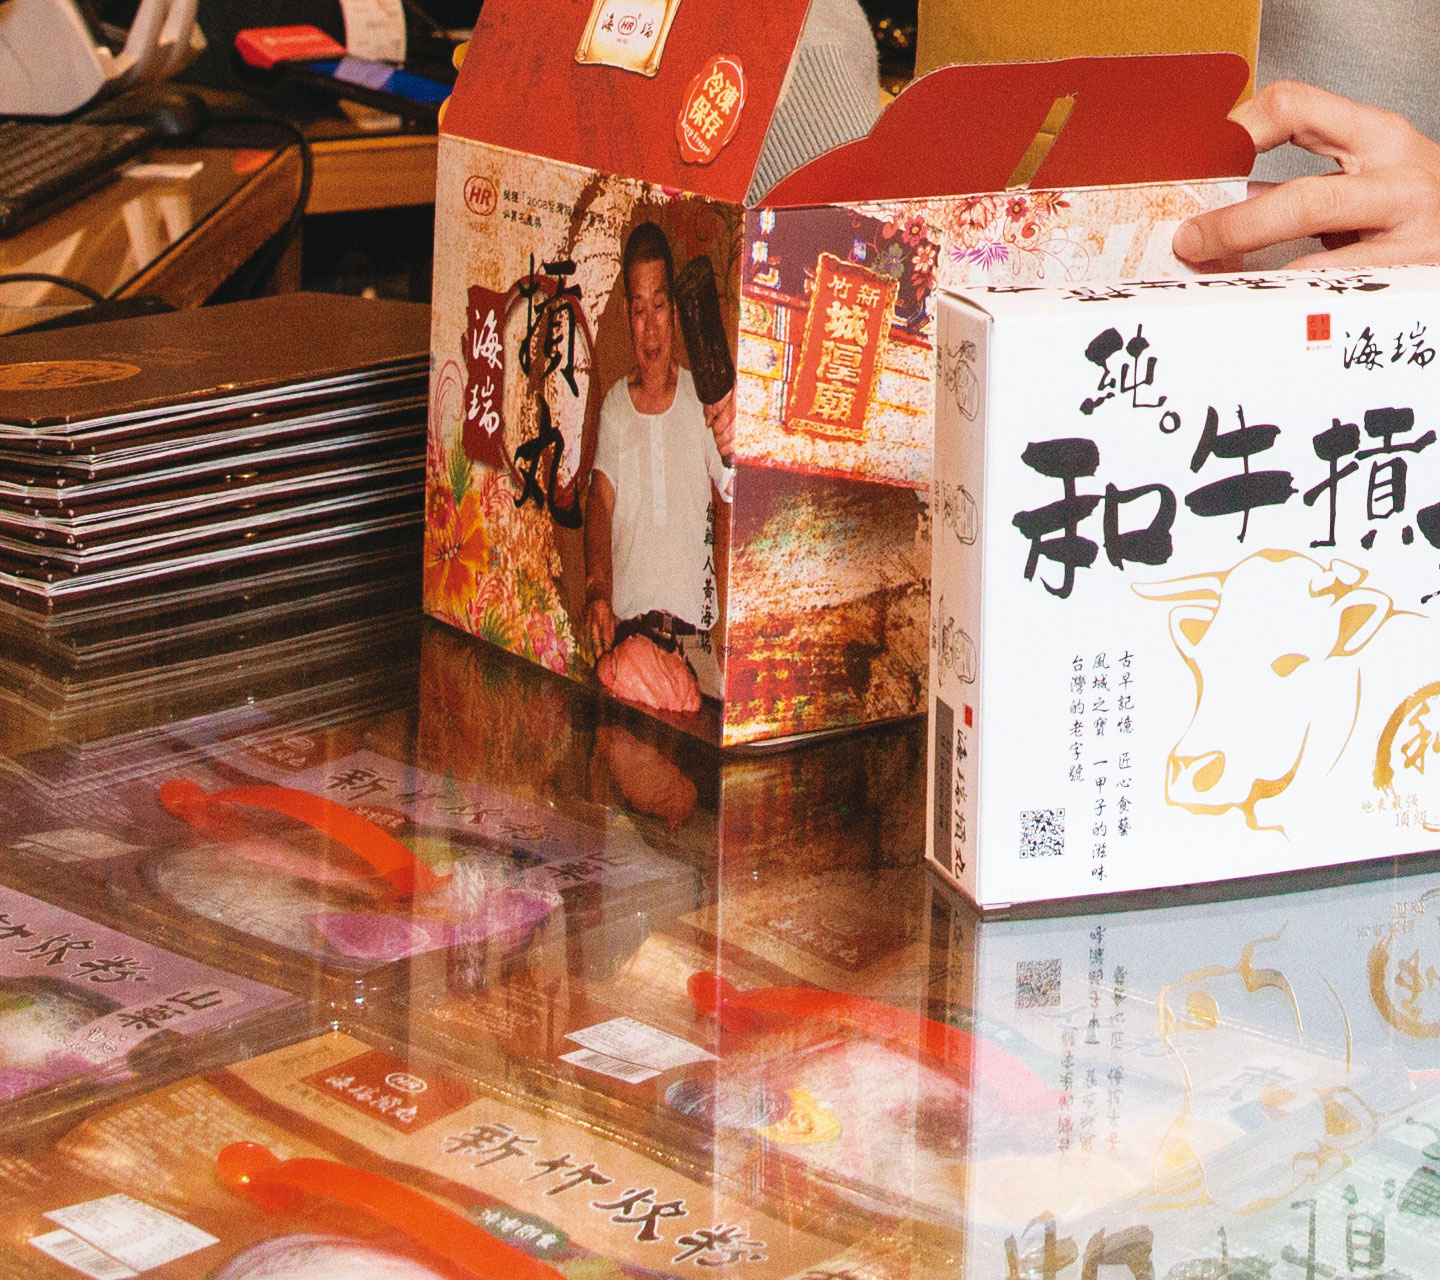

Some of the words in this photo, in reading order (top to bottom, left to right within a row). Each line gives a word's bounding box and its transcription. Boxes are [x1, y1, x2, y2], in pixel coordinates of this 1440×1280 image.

[688, 93, 725, 140] 保存
[703, 65, 741, 115] 冷凍
[468, 185, 493, 208] HR
[467, 307, 504, 438] 海瑞
[513, 252, 584, 530] 摃丸
[807, 301, 869, 423] 城隍廟
[1067, 653, 1088, 783] 台灣的老字號
[1091, 651, 1111, 737] 風城之寶
[1116, 649, 1135, 734] 古早記憶
[1091, 757, 1109, 882] 一甲子的滋味
[1115, 750, 1133, 837] 匠心食藝
